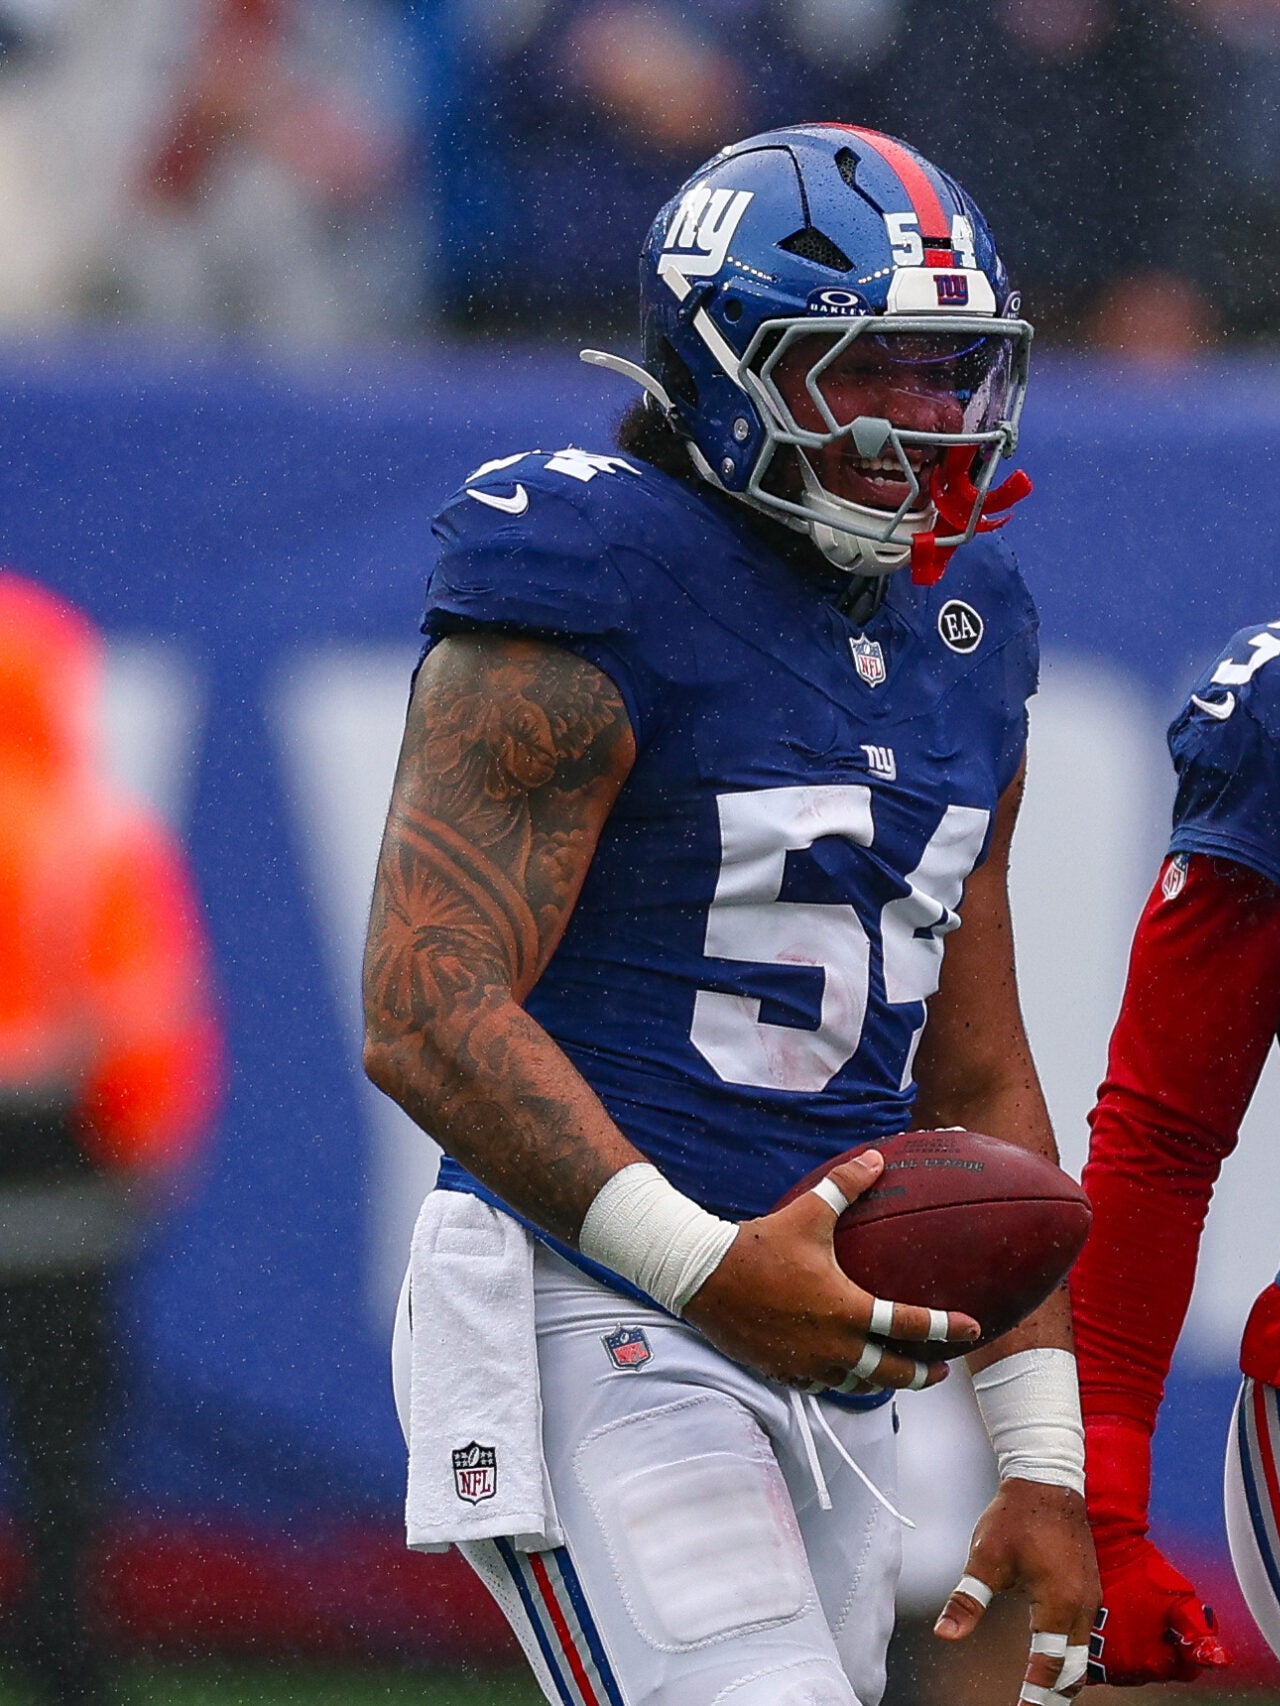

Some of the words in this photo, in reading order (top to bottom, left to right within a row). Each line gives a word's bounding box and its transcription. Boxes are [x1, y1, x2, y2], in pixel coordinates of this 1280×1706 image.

[810, 303, 867, 316] OAKLEY
[944, 611, 978, 641] EA
[860, 655, 882, 678] NFL
[690, 784, 992, 1093] 54
[458, 1469, 492, 1497] NFL
